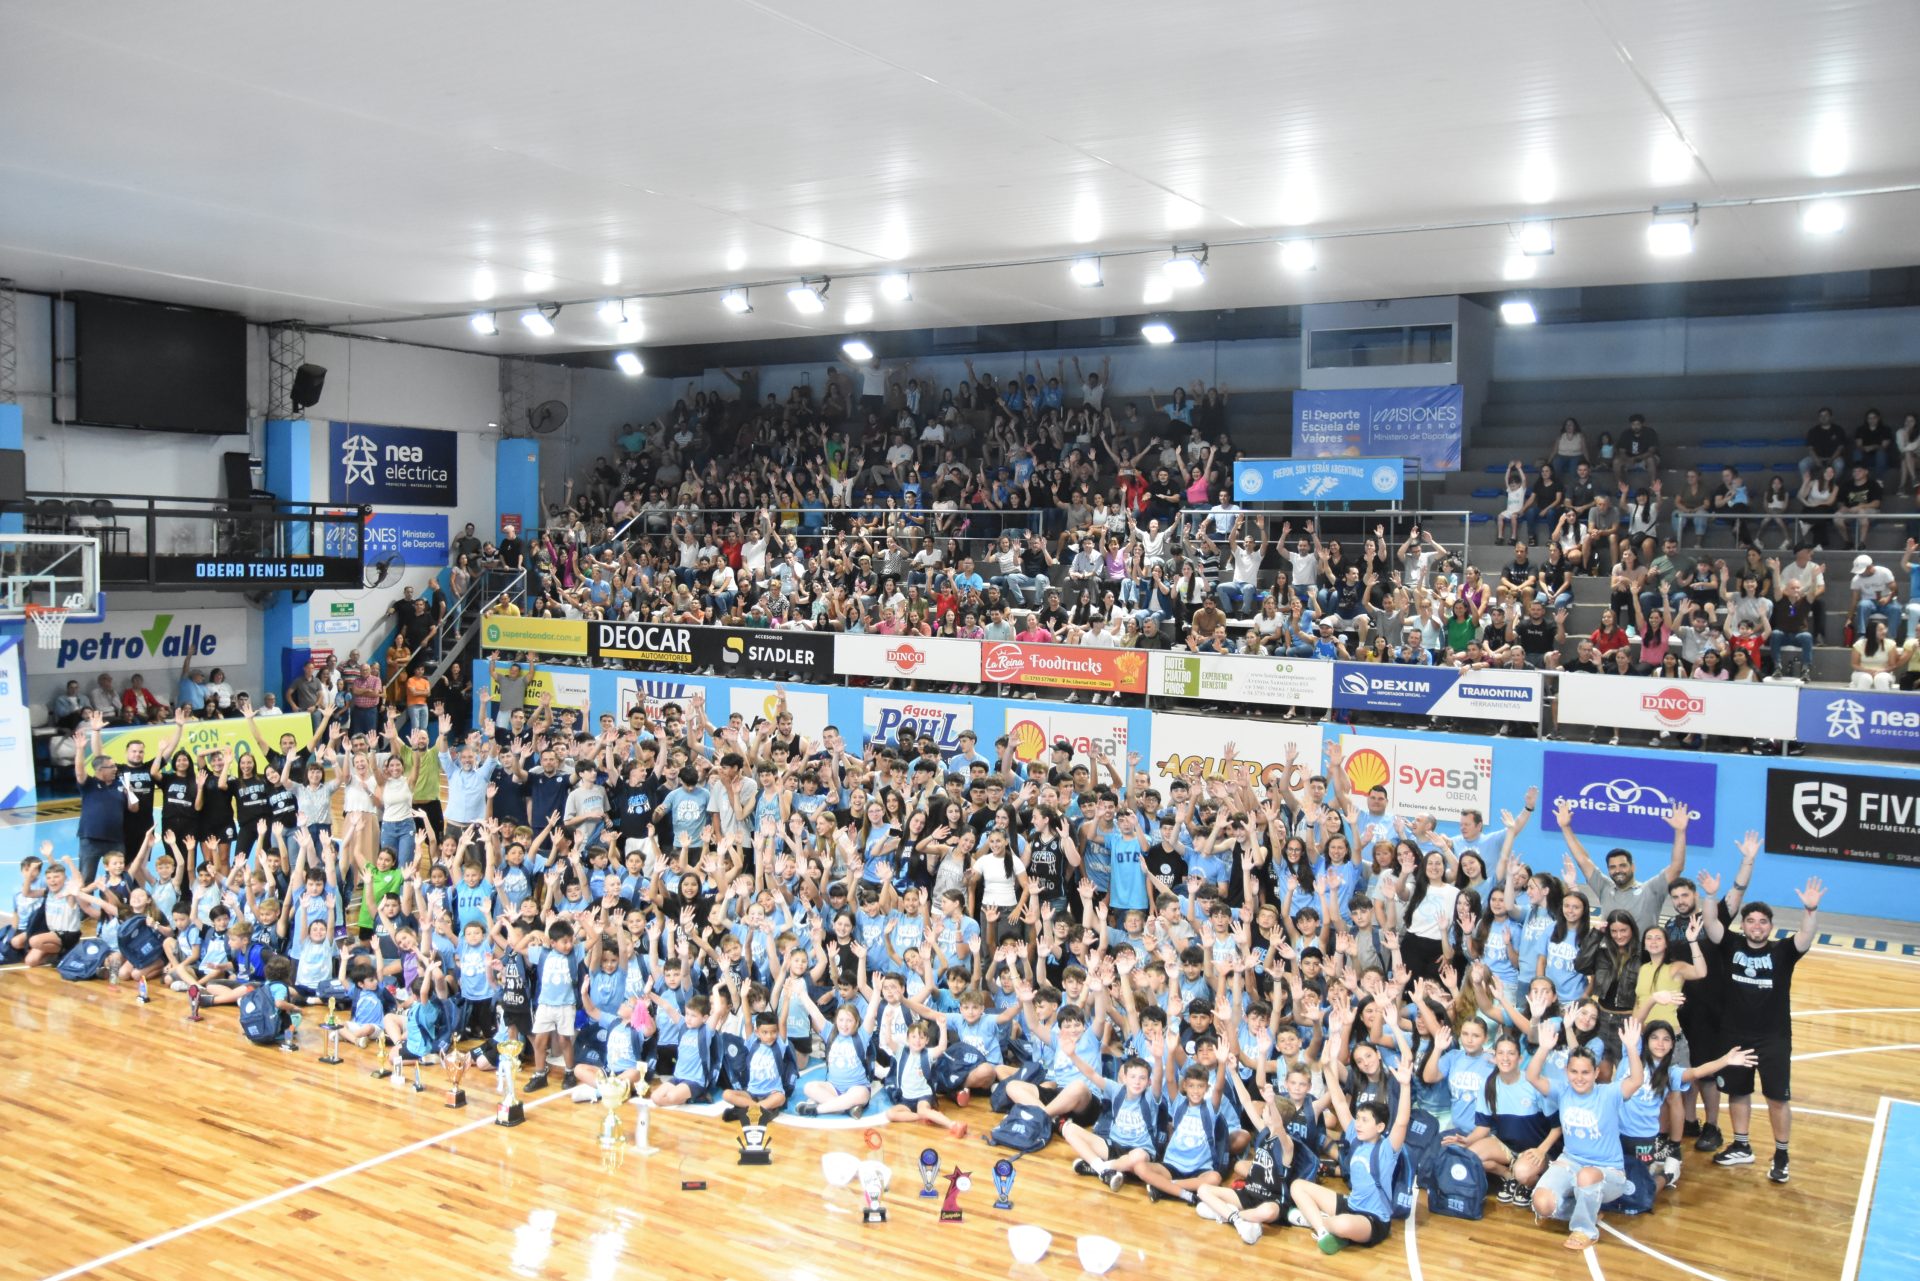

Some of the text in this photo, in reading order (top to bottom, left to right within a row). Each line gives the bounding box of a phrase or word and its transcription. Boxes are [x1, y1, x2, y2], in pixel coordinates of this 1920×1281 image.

[1302, 410, 1360, 422] El Deporte
[1374, 406, 1456, 422] MISIONES
[1302, 422, 1360, 432] Escuela de
[1302, 434, 1342, 443] Valores
[1374, 432, 1409, 441] Ministerio
[1422, 432, 1457, 441] Deportes
[386, 445, 423, 463] nea
[385, 464, 448, 481] eléctrica
[402, 529, 435, 539] Ministerio
[402, 540, 445, 549] de Deportes
[196, 563, 324, 578] OBERA TENIS CLUB
[599, 625, 691, 653] DEOCAR
[641, 652, 688, 662] AUTOMOTORES
[749, 646, 815, 665] STADLER
[888, 652, 923, 662] DINCO
[1029, 653, 1102, 675] Foodtrucks
[1165, 657, 1186, 670] HOTEL
[1165, 670, 1191, 682] CUATRO
[1202, 672, 1232, 681] EXPERIENCIA
[1165, 682, 1185, 694] PINOS
[1371, 679, 1430, 692] DEXIM
[1462, 686, 1528, 699] TRAMONTINA
[1470, 701, 1521, 709] HERRAMIENTAS
[1644, 697, 1701, 711] DINCO
[903, 704, 942, 718] Aguas
[189, 729, 218, 744] DON
[1870, 728, 1920, 737] PROYECTOS
[1399, 764, 1478, 794] syasa
[1446, 791, 1478, 802] OBERA
[1399, 802, 1427, 810] Estaciones
[1628, 804, 1701, 820] muno
[460, 897, 482, 908] OTC
